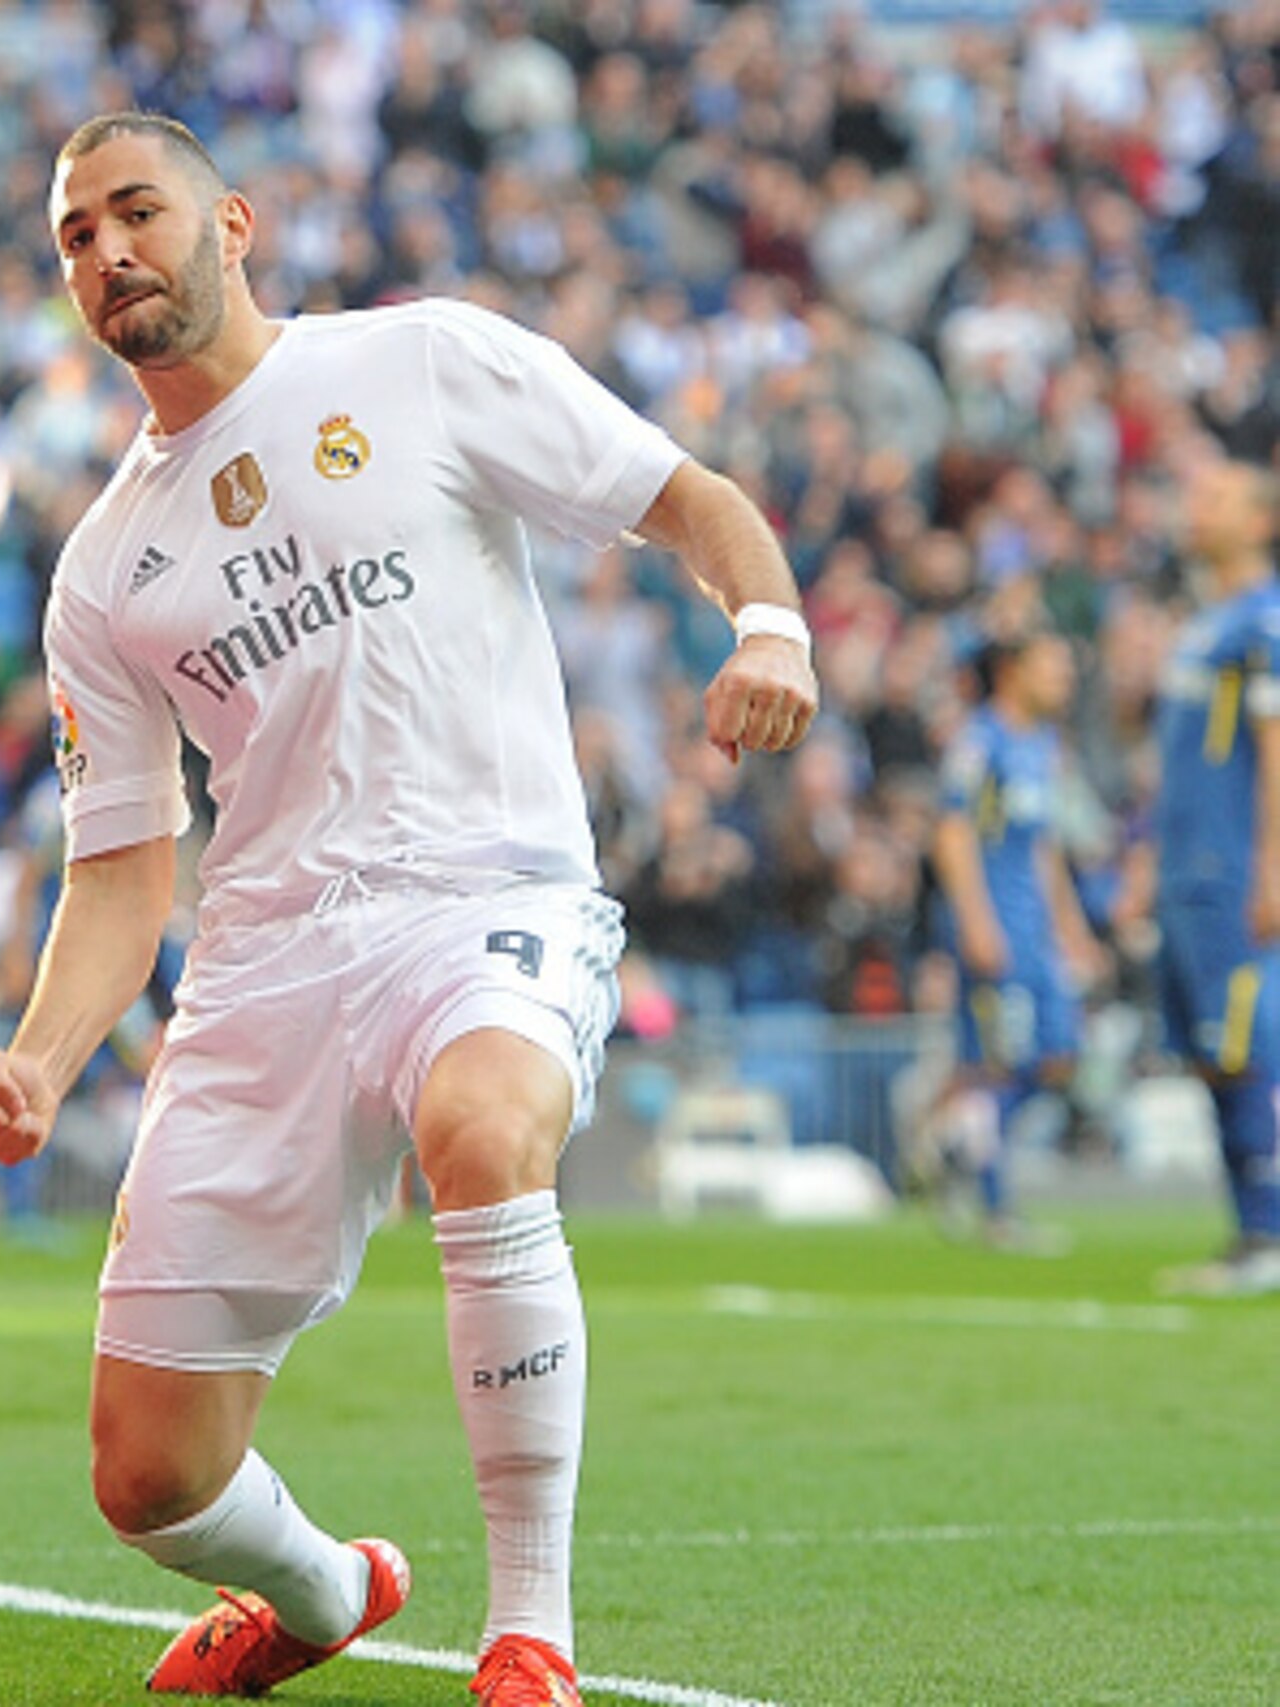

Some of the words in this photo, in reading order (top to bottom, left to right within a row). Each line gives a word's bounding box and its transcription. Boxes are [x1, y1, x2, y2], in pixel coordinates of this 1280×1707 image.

[219, 534, 302, 600] Fly
[174, 550, 416, 702] Emirates
[485, 929, 544, 979] 9
